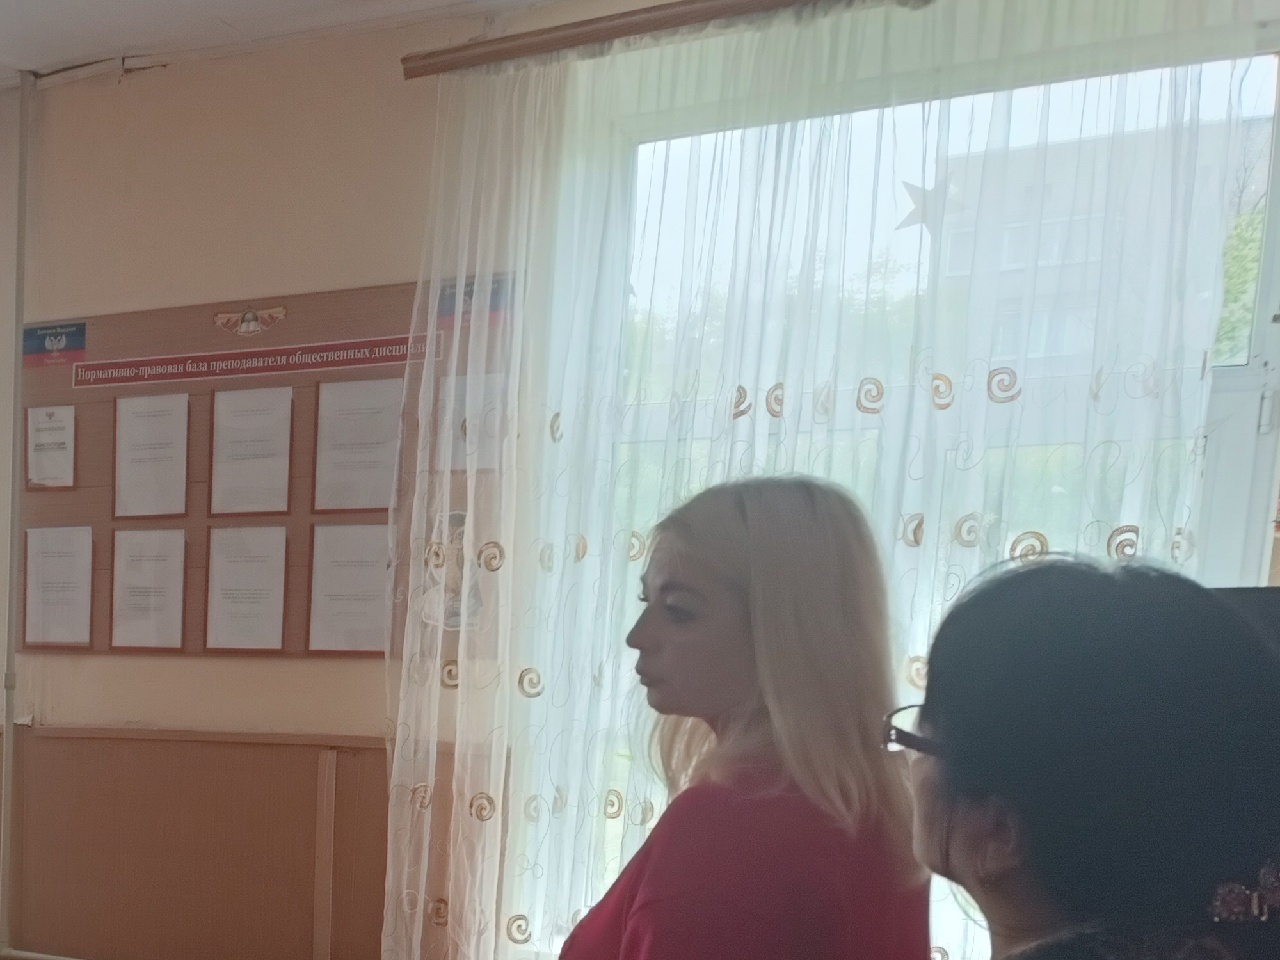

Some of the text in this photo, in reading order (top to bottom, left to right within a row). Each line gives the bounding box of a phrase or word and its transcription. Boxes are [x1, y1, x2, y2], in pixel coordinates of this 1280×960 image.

[77, 364, 184, 382] Нормативно-правовая
[185, 360, 208, 373] база
[210, 354, 287, 372] преподавателя
[289, 347, 370, 365] общественных
